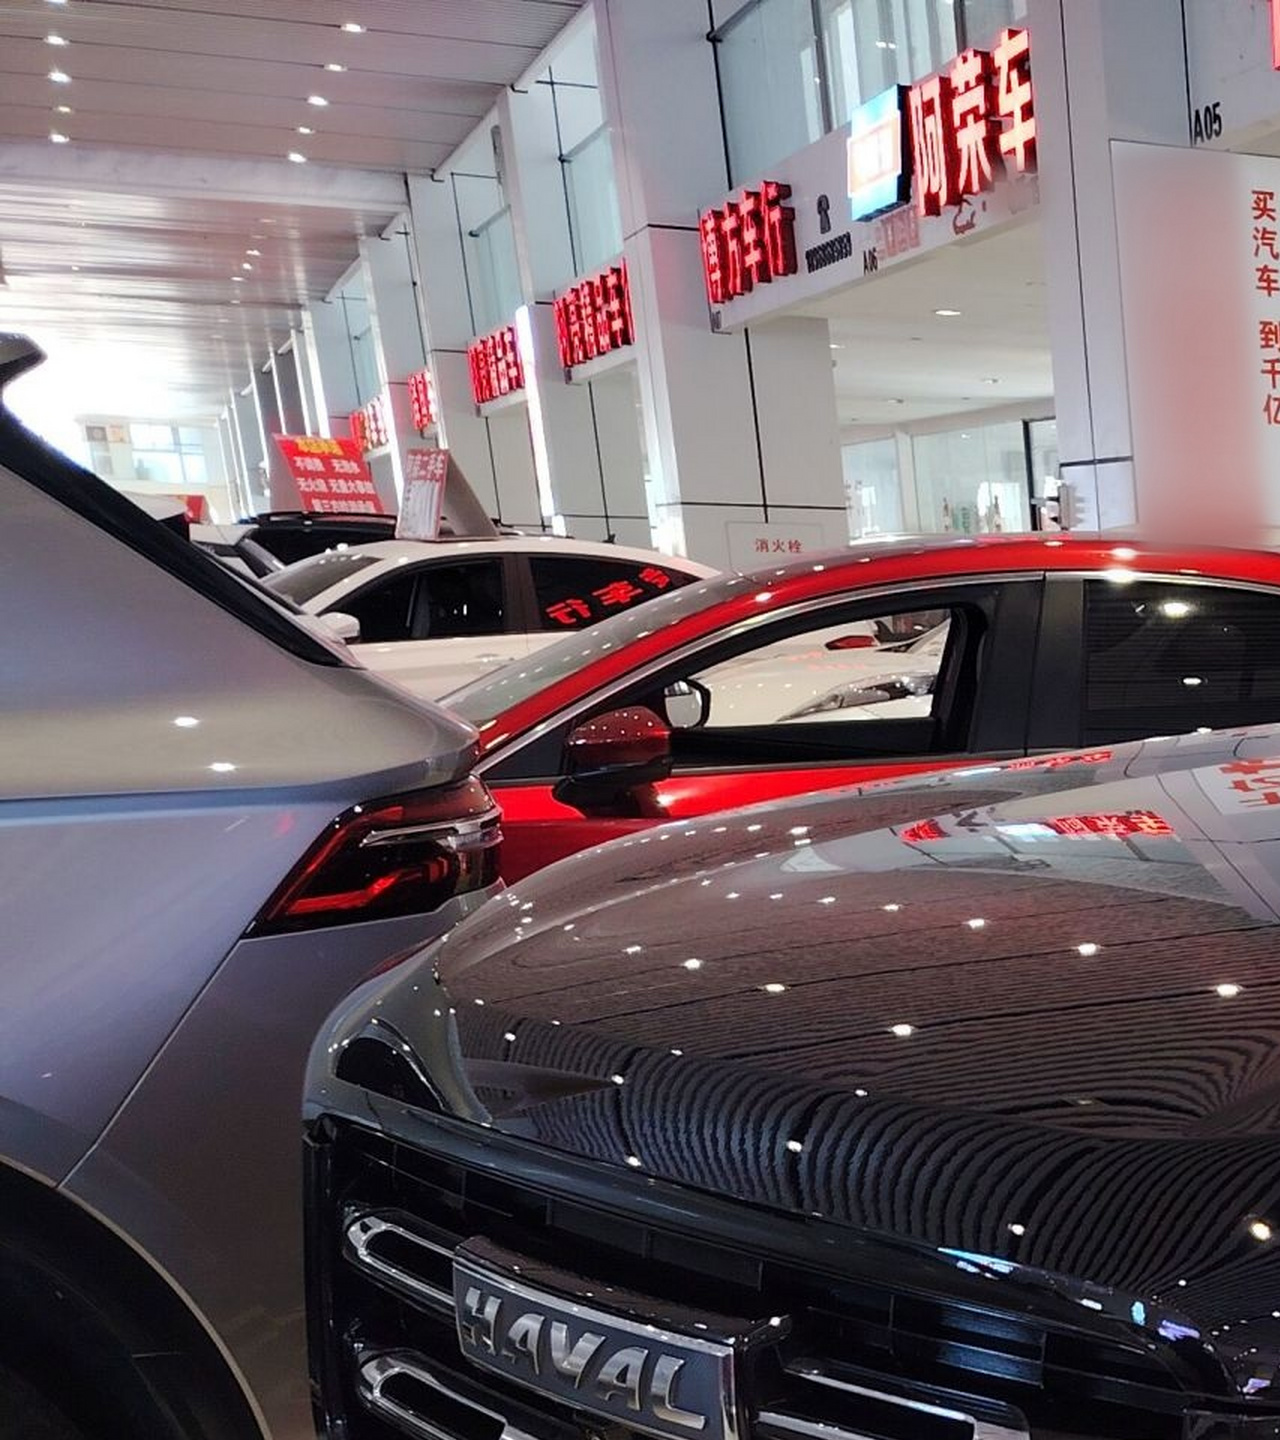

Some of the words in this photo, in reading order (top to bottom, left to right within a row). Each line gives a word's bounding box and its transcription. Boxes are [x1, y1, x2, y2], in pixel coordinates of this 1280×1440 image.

[908, 28, 1038, 216] 阿荣车
[1193, 102, 1222, 145] A05
[1252, 189, 1280, 297] 买汽车
[755, 538, 802, 554] 消火栓
[464, 1287, 706, 1431] HAVAL
